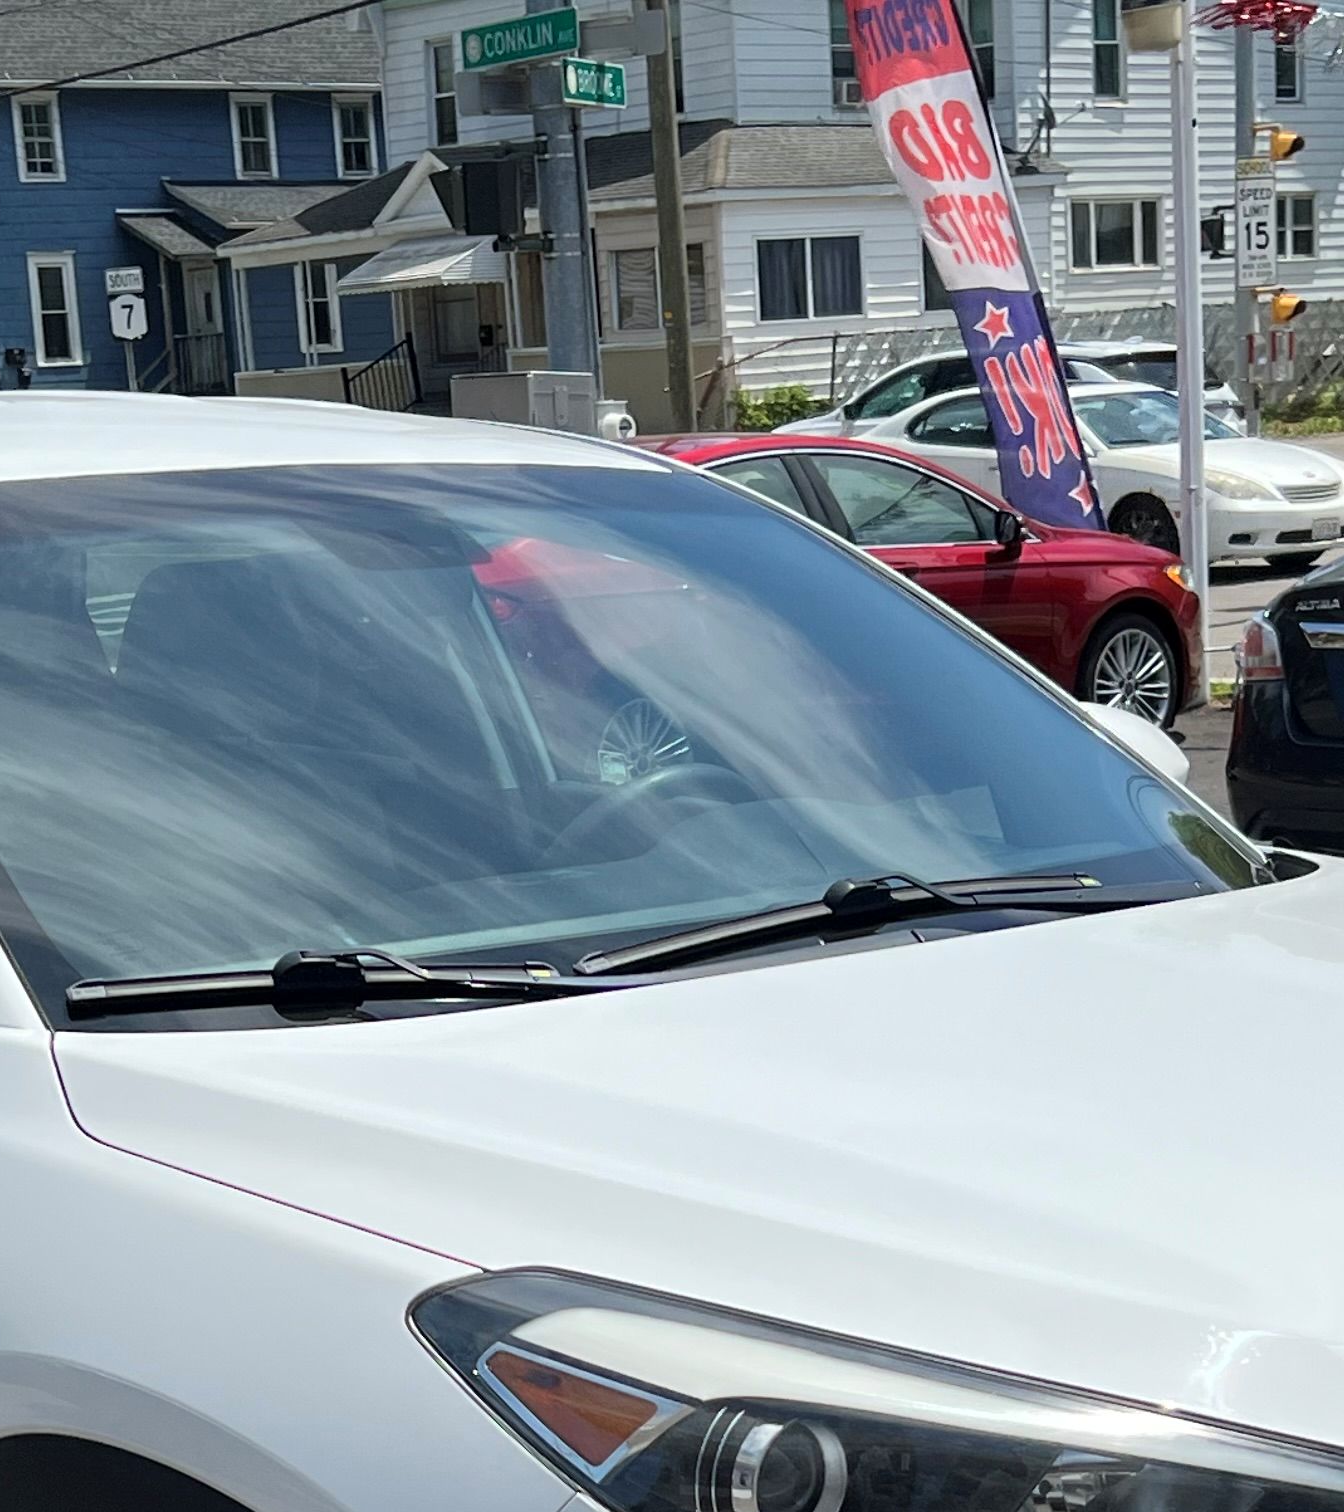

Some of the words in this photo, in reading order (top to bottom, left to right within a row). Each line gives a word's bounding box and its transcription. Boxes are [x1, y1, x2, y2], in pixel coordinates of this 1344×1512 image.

[484, 21, 554, 58] CONKLIN
[1237, 162, 1272, 176] SCHOOL
[1239, 187, 1273, 201] SPEED
[1243, 204, 1270, 218] LIMIT
[1245, 221, 1270, 251] 15
[108, 273, 141, 289] SOUTH
[121, 304, 134, 330] 7
[1294, 598, 1341, 612] ALTIMA
